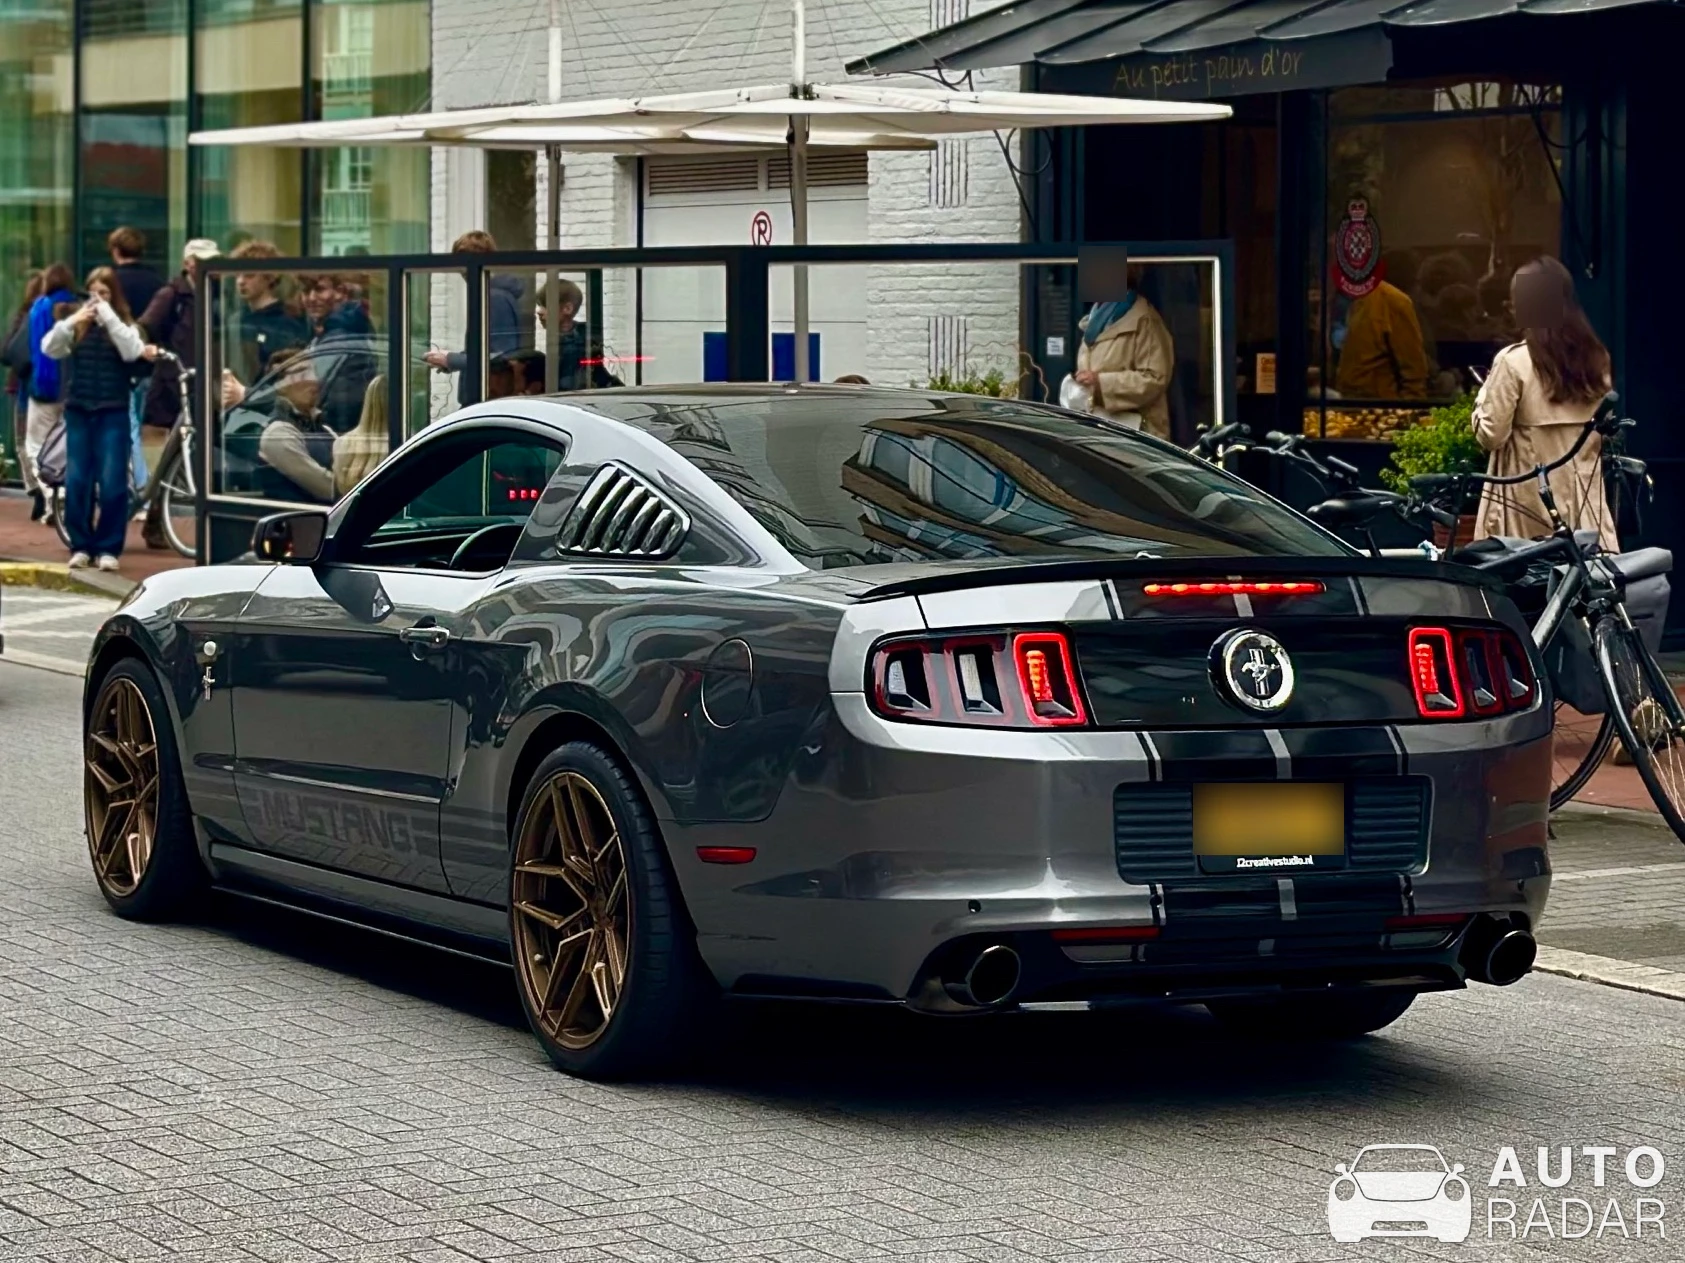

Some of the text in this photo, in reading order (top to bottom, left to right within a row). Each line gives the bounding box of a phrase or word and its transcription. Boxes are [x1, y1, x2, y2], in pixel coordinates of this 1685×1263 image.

[1113, 48, 1305, 98] Au petit pain d'or
[262, 790, 411, 852] MUSTANG
